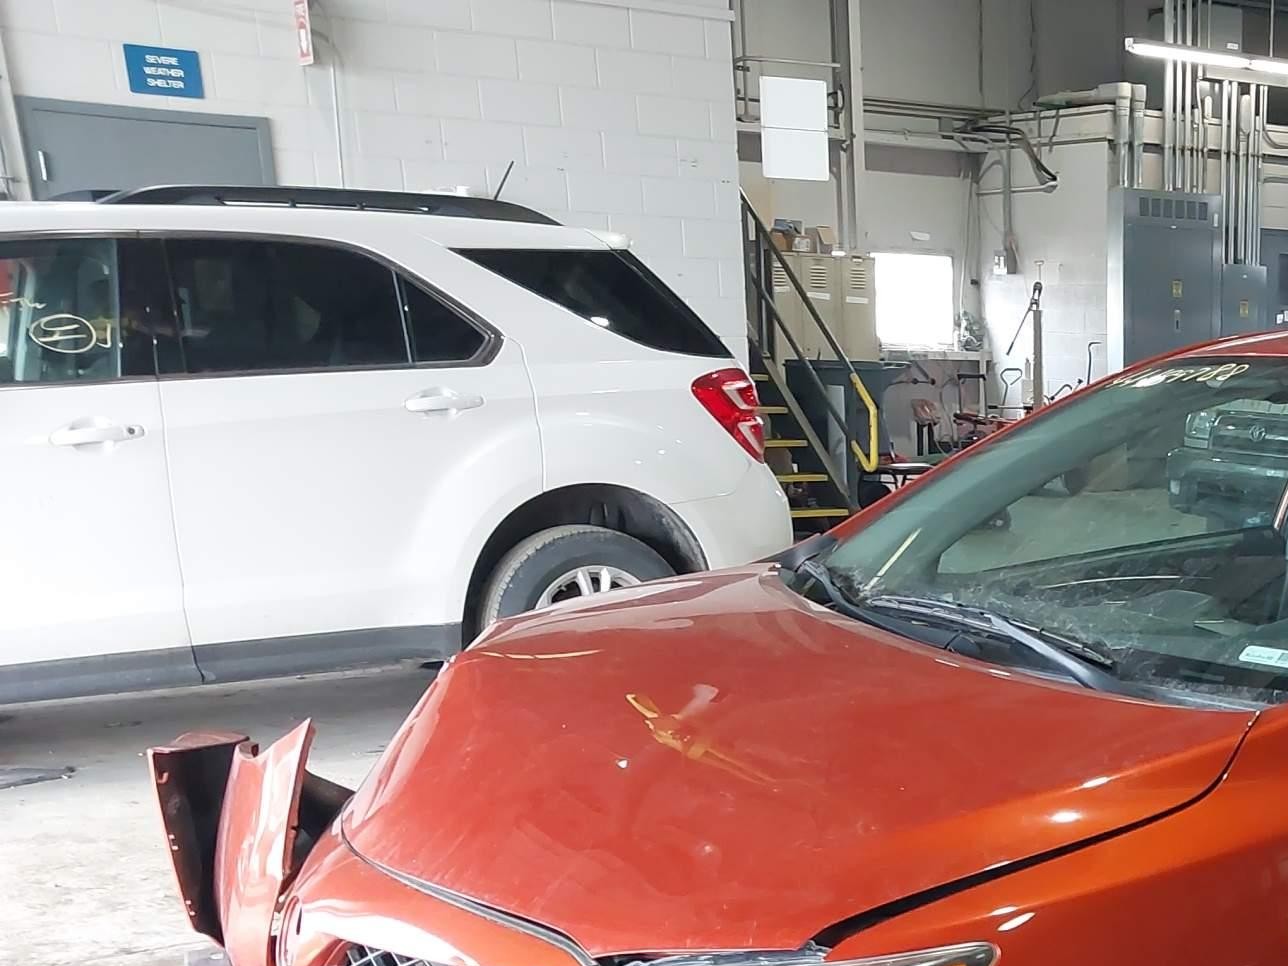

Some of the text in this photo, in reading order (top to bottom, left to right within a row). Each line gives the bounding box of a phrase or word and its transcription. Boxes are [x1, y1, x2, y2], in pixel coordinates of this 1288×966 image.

[144, 54, 180, 66] SEVERE
[143, 66, 185, 78] WEATHER
[146, 78, 185, 89] SHELTER
